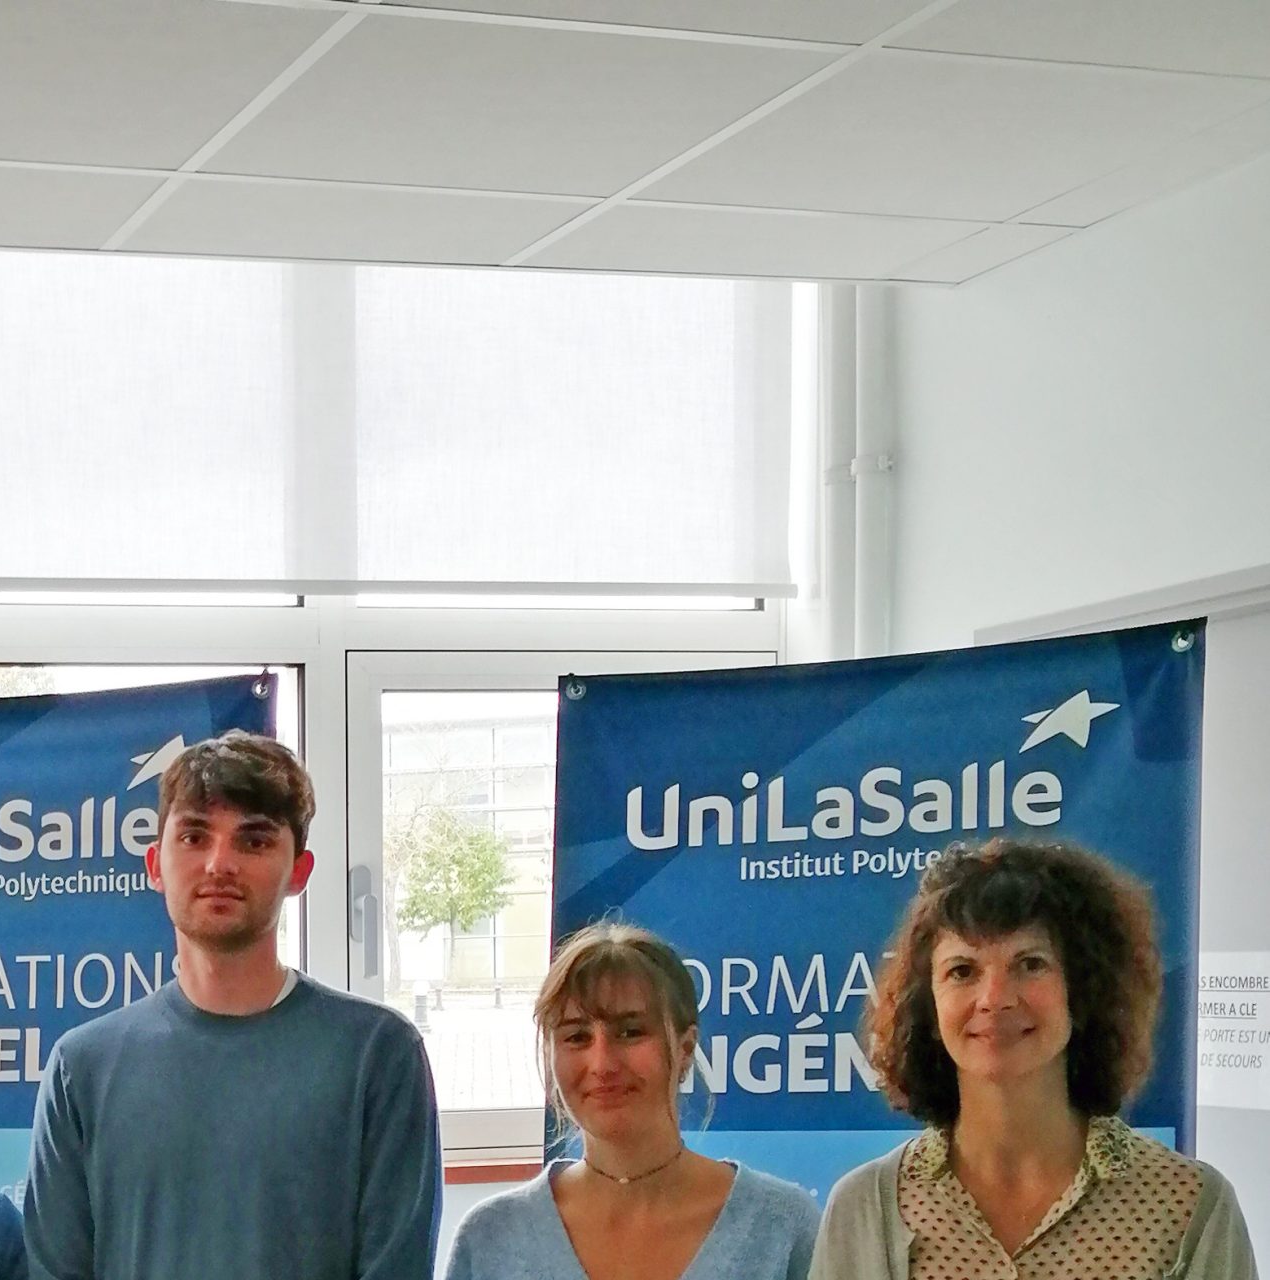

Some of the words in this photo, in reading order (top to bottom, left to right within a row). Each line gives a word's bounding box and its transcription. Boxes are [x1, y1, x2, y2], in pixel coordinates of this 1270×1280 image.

[627, 760, 1063, 851] UniLaSalle
[740, 851, 845, 881] Institut
[1209, 976, 1269, 989] ENCOMBRE
[1229, 1003, 1237, 1016] A
[1239, 1003, 1257, 1017] CLE
[1203, 1028, 1236, 1044] PORTE
[1238, 1030, 1256, 1044] EST
[1216, 1053, 1263, 1069] SECOURS
